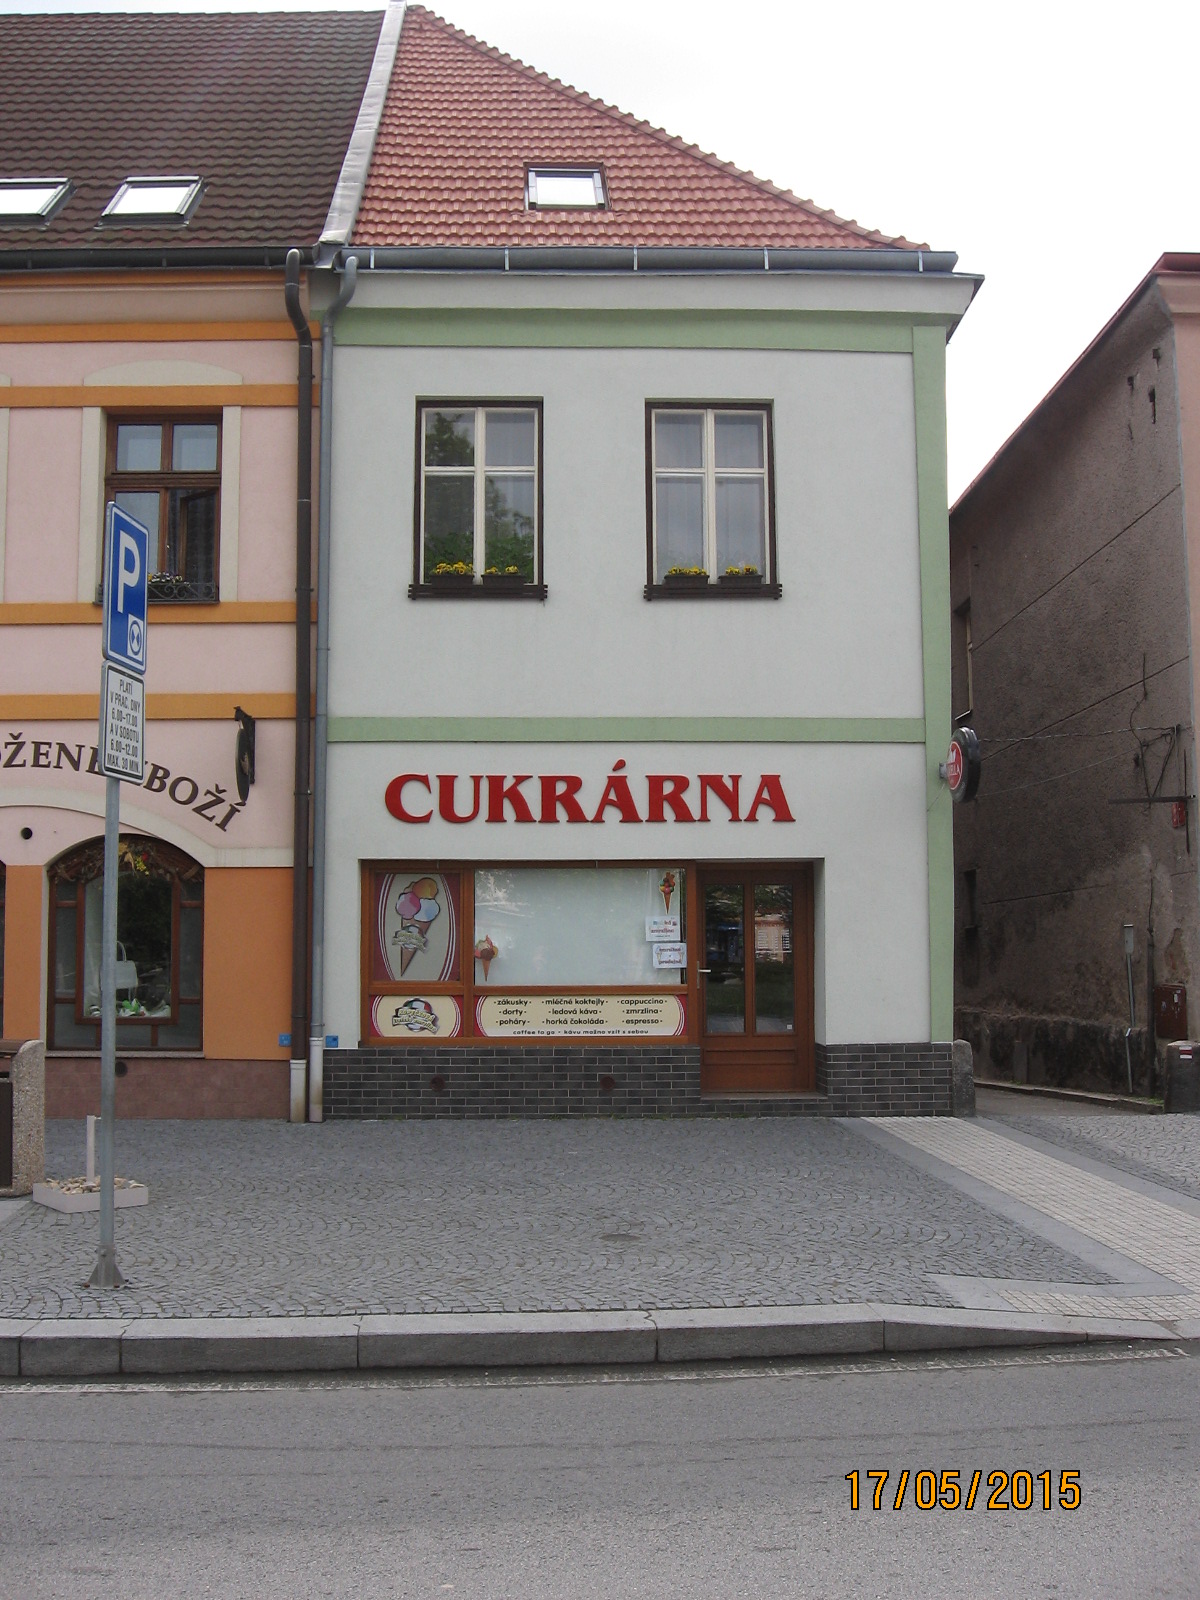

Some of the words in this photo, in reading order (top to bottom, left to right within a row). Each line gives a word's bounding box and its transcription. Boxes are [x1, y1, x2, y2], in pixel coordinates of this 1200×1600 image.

[117, 529, 141, 614] P
[119, 679, 133, 695] PLATÍ
[110, 691, 114, 704] V
[114, 693, 129, 709] PRAC.
[130, 699, 141, 713] DNY
[110, 722, 114, 735] A
[115, 724, 119, 736] V
[119, 726, 139, 743] SOBOTU
[107, 753, 121, 768] MAX.
[122, 757, 128, 770] 30
[384, 757, 797, 824] CUKRÁRNA
[497, 998, 528, 1006] zákusky
[574, 998, 605, 1006] koktejly
[620, 997, 664, 1006] cappuccino
[502, 1008, 523, 1016] dorty
[499, 1018, 526, 1026] poháry
